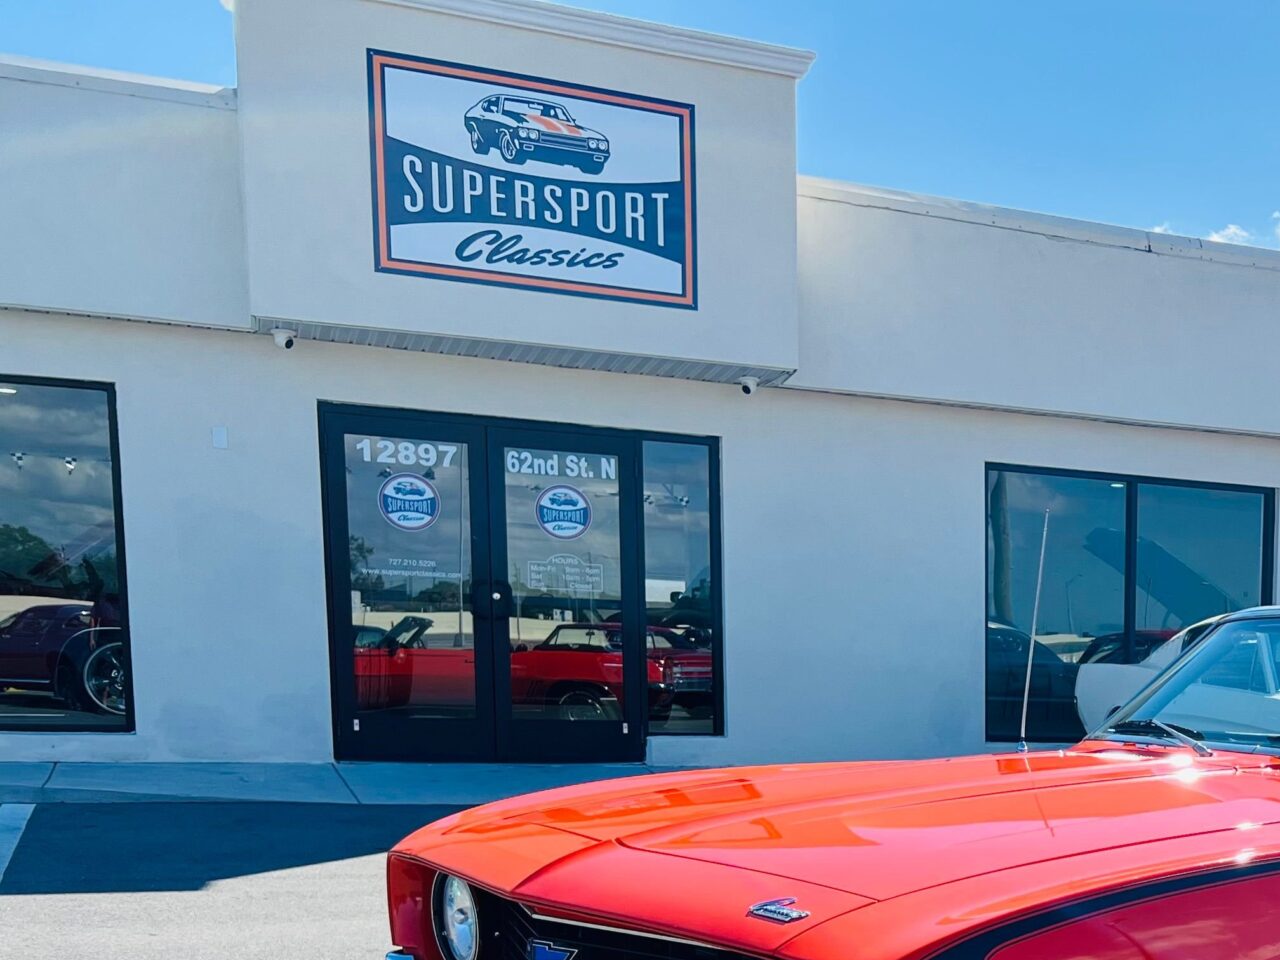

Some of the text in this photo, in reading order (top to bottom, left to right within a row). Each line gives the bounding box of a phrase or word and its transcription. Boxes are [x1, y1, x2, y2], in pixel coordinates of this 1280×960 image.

[402, 154, 669, 247] SUPERSPORT
[455, 229, 624, 269] Classics
[356, 438, 457, 467] 12897
[506, 450, 616, 480] 62nd St. N
[387, 498, 431, 514] SUPERSPORT
[543, 508, 584, 523] SUPERSPORT
